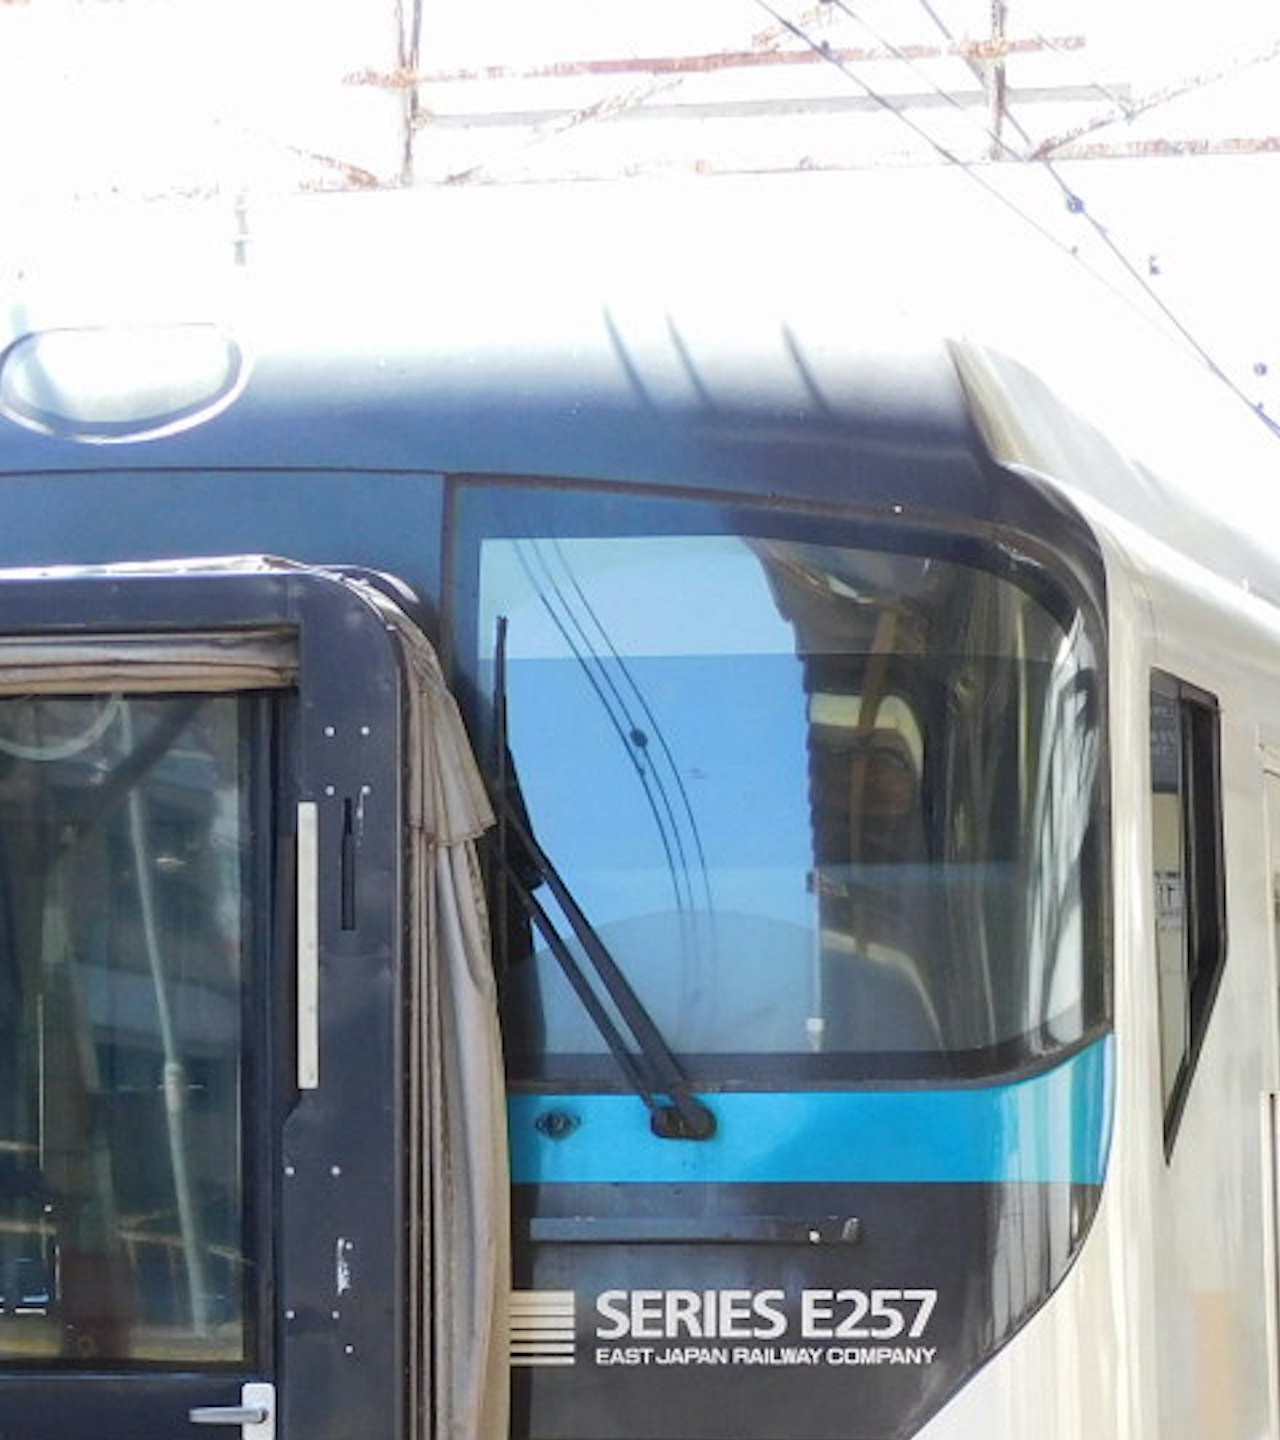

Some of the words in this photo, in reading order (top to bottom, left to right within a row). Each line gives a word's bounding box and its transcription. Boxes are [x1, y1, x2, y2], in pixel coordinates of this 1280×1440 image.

[595, 1289, 788, 1340] SERIES
[801, 1289, 938, 1340] E257
[595, 1348, 654, 1365] EAST
[655, 1348, 729, 1365] JAPAN
[731, 1348, 822, 1365] RAILWAY
[825, 1347, 937, 1365] COMPANY
